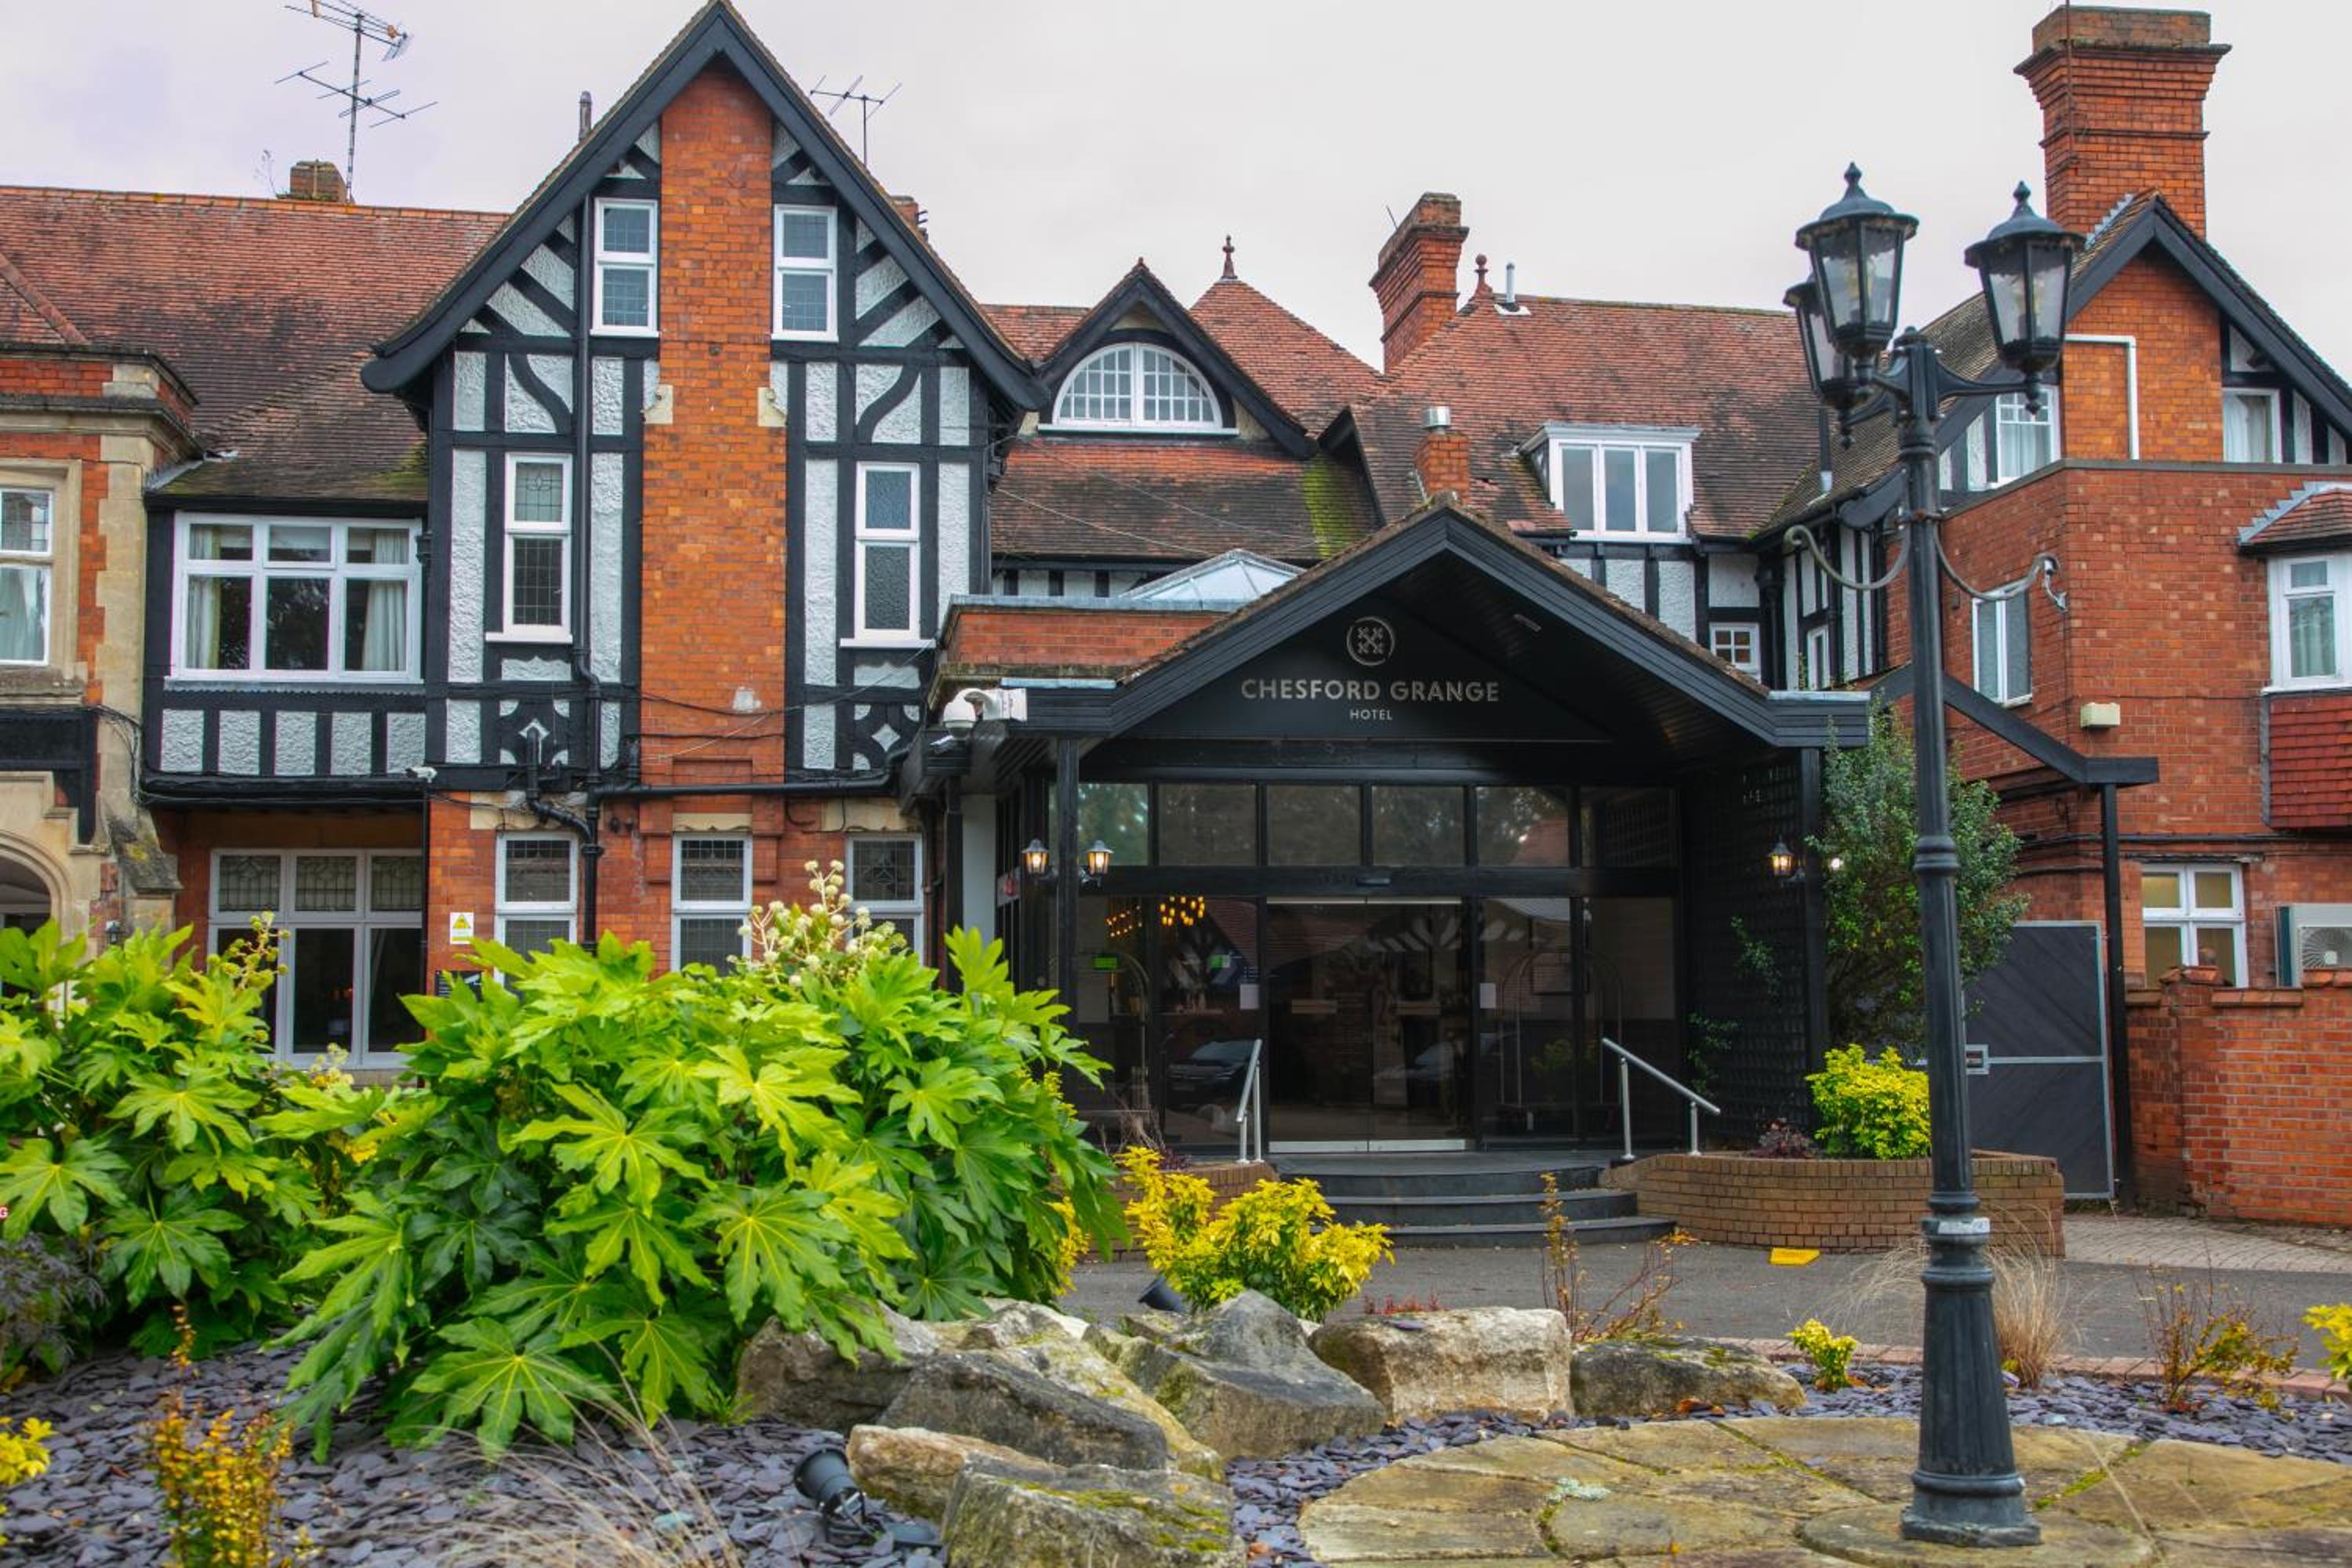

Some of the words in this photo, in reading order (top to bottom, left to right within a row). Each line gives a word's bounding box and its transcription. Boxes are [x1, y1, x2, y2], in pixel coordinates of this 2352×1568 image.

[1241, 678, 1381, 700] CHESFORD
[1390, 681, 1499, 702] GRANGE
[1350, 709, 1392, 720] HOTEL
